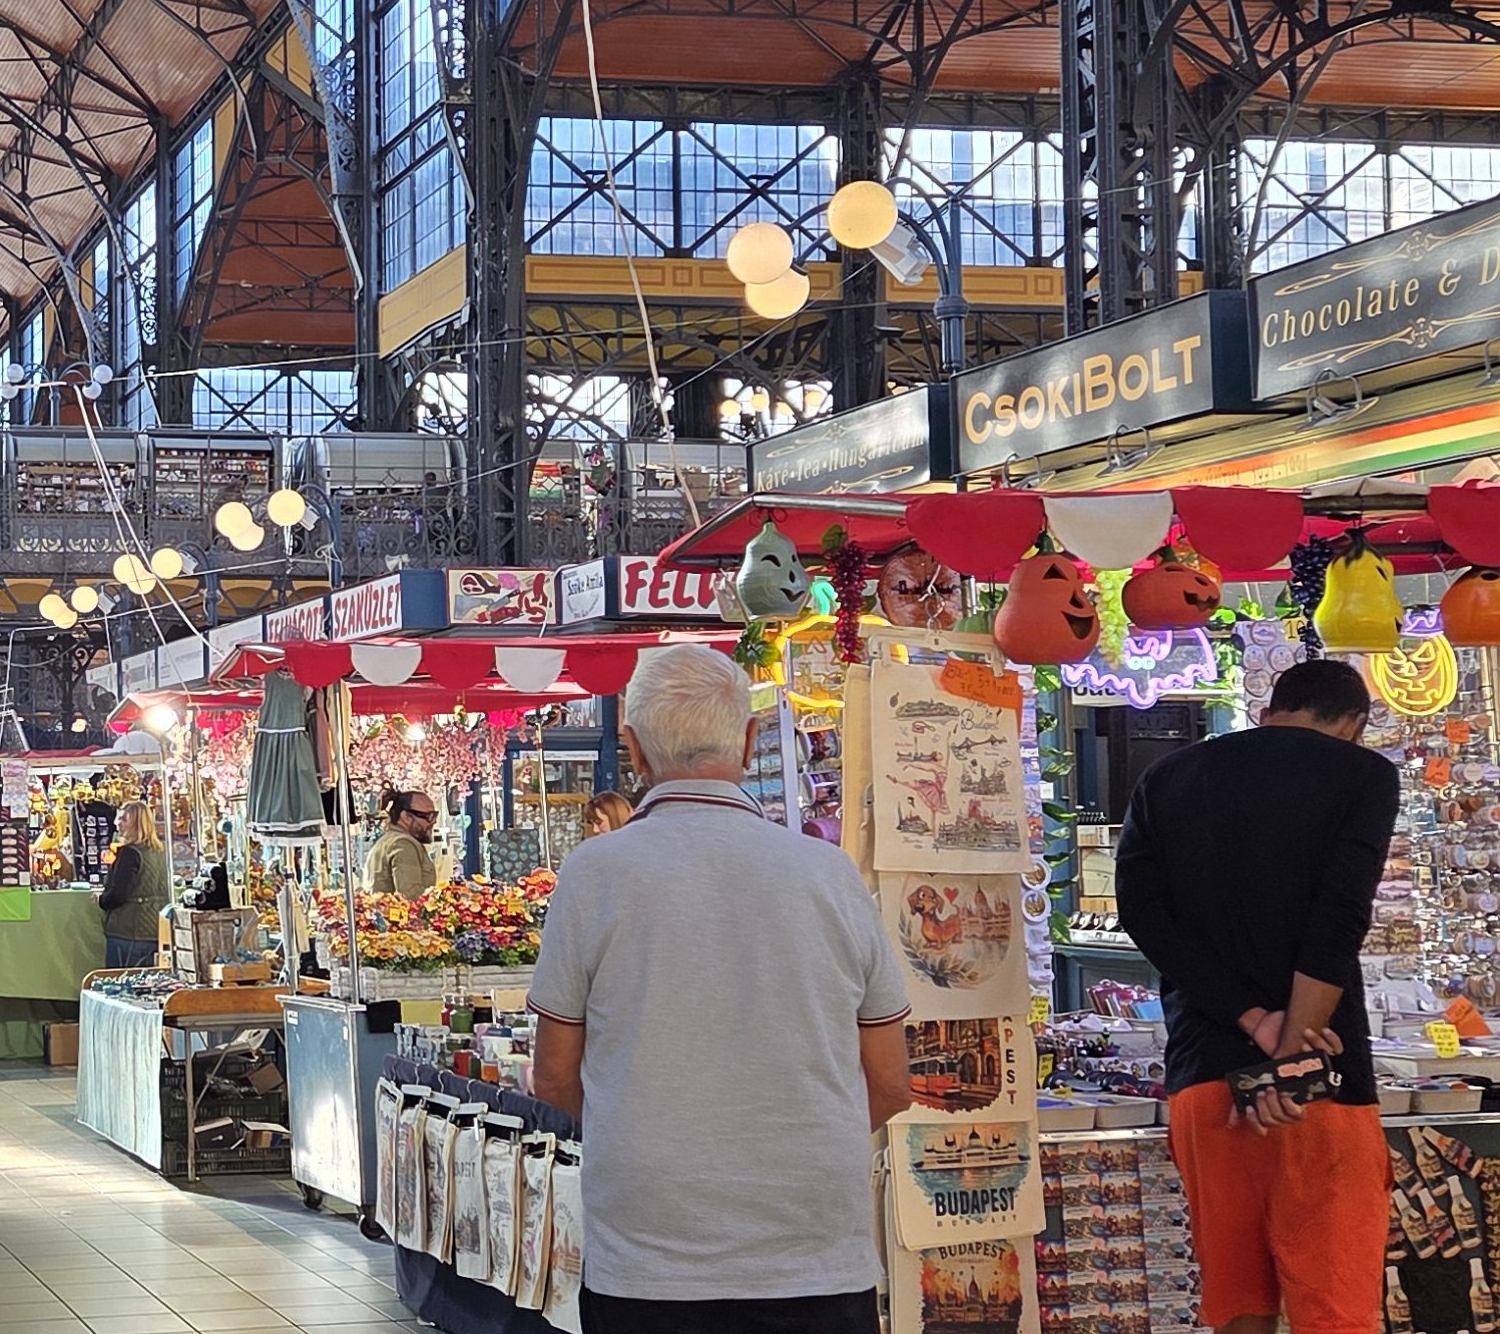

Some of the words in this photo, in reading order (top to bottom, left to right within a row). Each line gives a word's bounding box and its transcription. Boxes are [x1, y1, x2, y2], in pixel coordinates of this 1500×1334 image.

[1262, 277, 1421, 348] Chocolate
[1438, 258, 1462, 297] &
[334, 583, 401, 638] SZAKÜZLET
[934, 1186, 1016, 1217] BUDAPEST
[937, 1241, 1006, 1261] BUDAPEST
